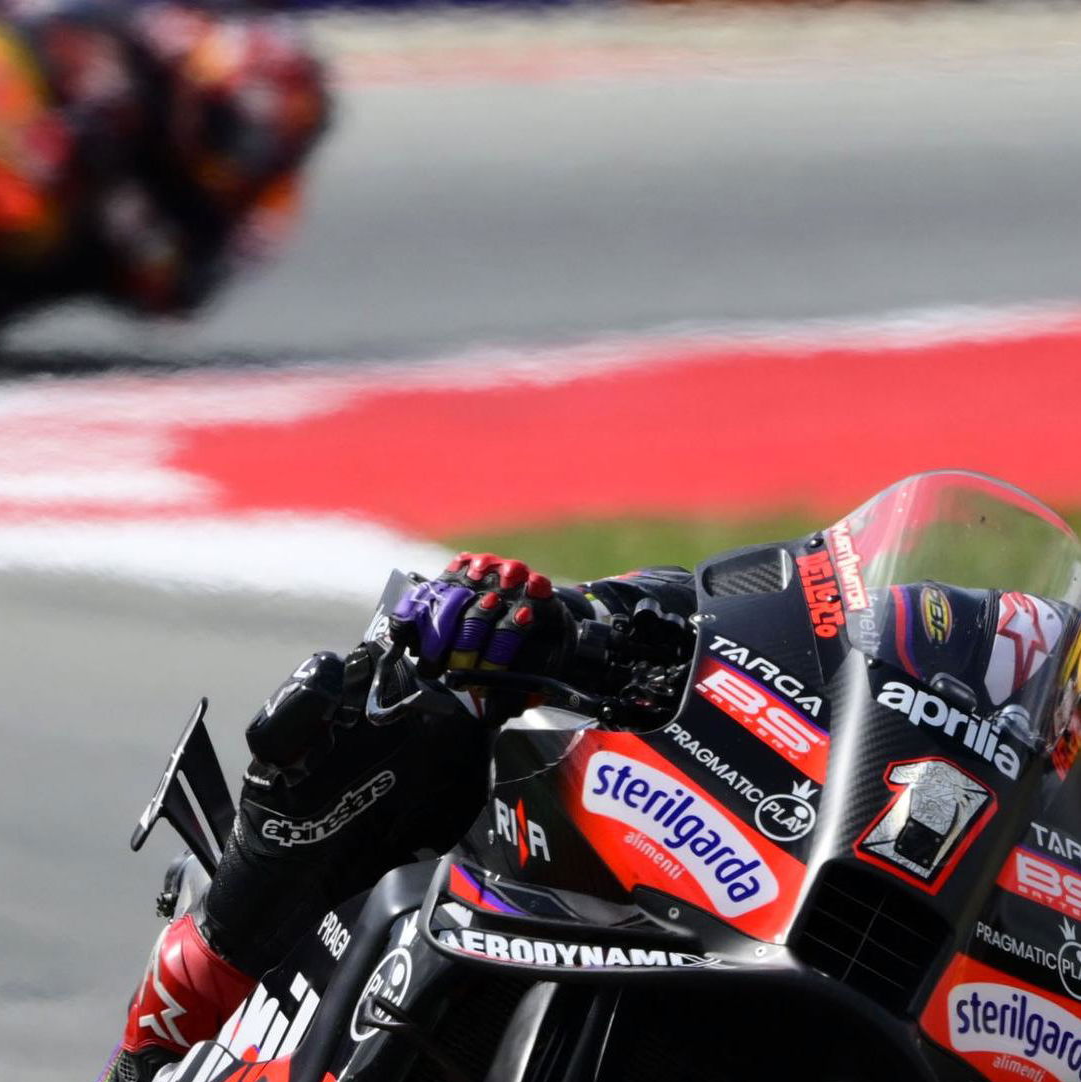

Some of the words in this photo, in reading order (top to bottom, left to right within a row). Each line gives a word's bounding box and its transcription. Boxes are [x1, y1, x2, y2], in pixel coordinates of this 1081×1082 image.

[702, 669, 821, 753] BS
[709, 635, 823, 717] TARGA
[876, 680, 1021, 782] aprilia
[261, 769, 397, 847] alpinestars
[664, 723, 764, 804] PRAGMATIC
[762, 800, 812, 834] PLAY
[861, 760, 991, 881] 1
[591, 763, 762, 904] sterilgarda
[623, 830, 685, 881] alimenti
[976, 921, 1058, 971] PRAGMATIC
